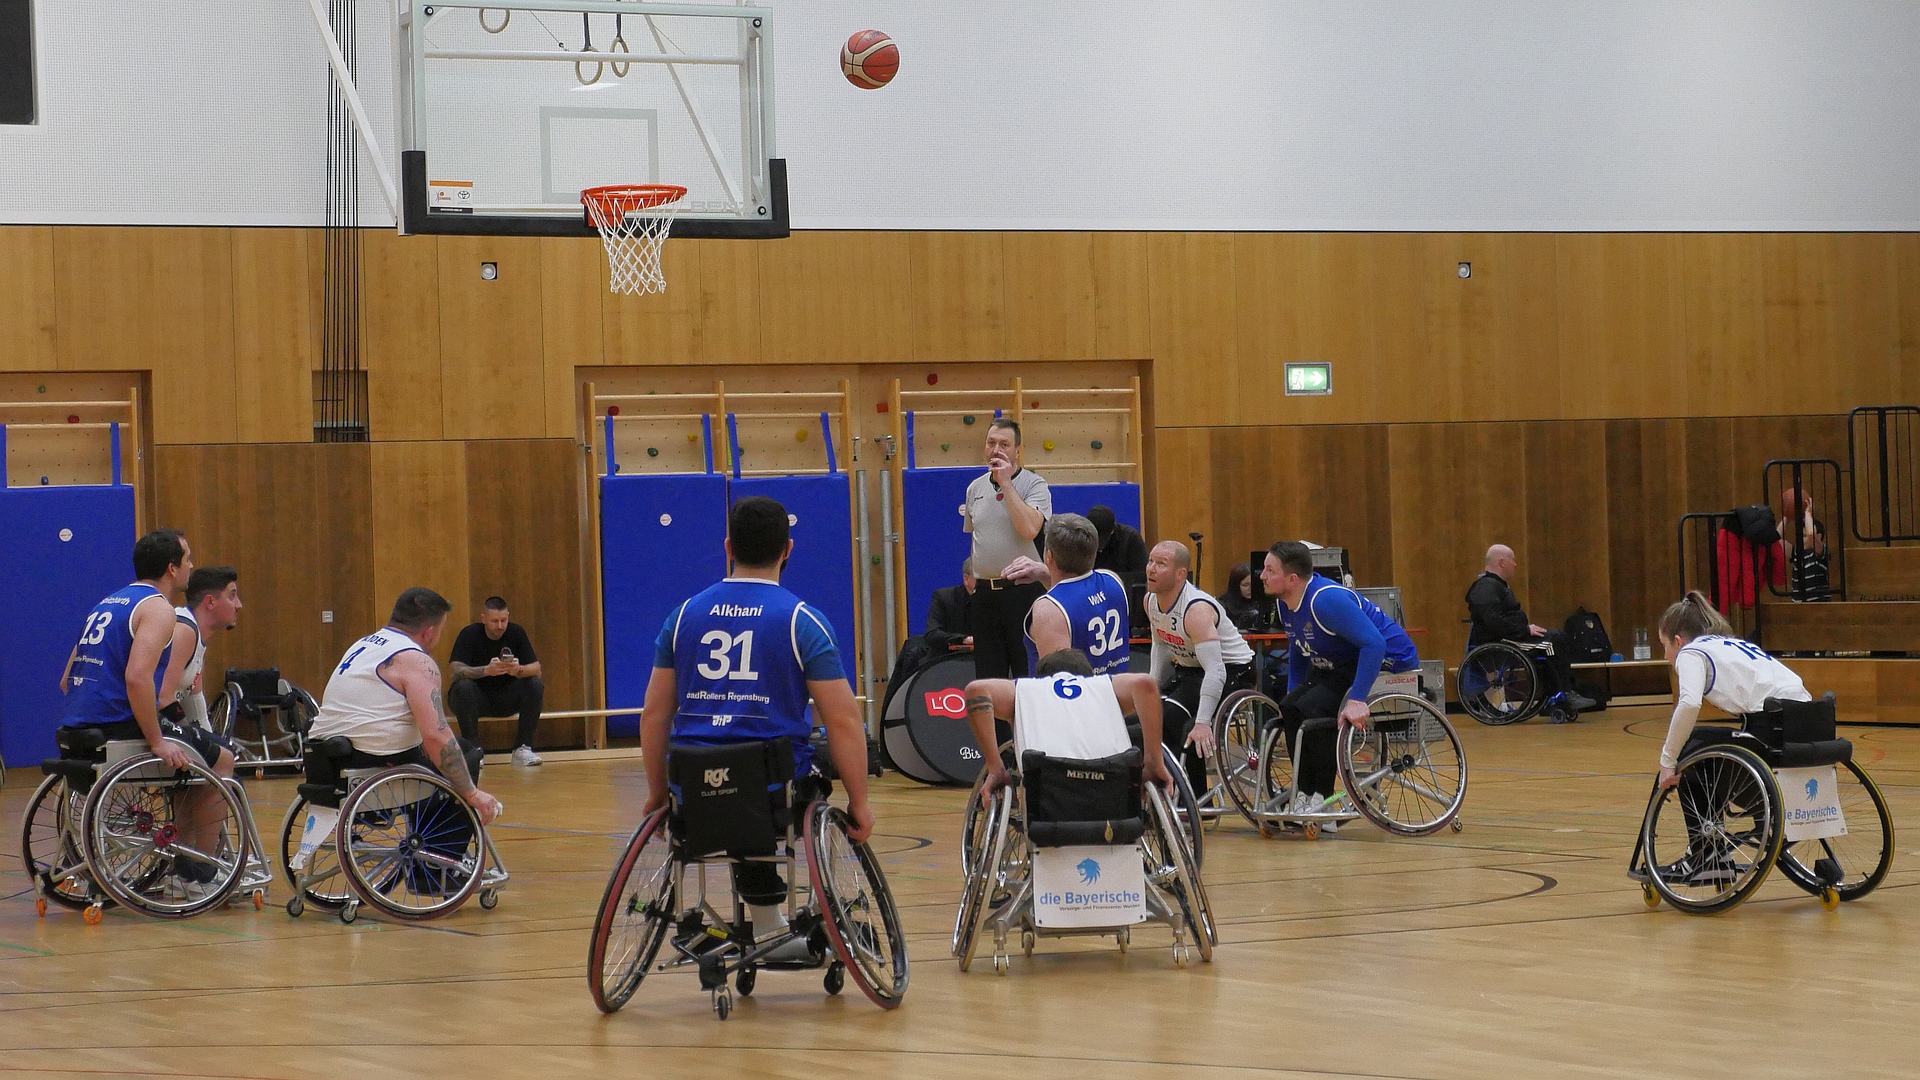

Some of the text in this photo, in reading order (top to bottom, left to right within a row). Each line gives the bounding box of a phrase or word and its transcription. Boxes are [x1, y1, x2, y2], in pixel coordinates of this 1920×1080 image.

[709, 604, 763, 617] Alkhani
[79, 611, 113, 645] 13
[1171, 617, 1177, 631] 3
[1088, 609, 1124, 656] 32
[339, 646, 367, 675] 4
[697, 630, 759, 680] 31
[1053, 679, 1082, 700] 6
[727, 691, 770, 704] Regensburg
[1066, 770, 1105, 781] MEYRA
[718, 788, 738, 796] SPORT
[1784, 805, 1837, 820] ie Bayerische
[1040, 891, 1139, 905] die Bayerische
